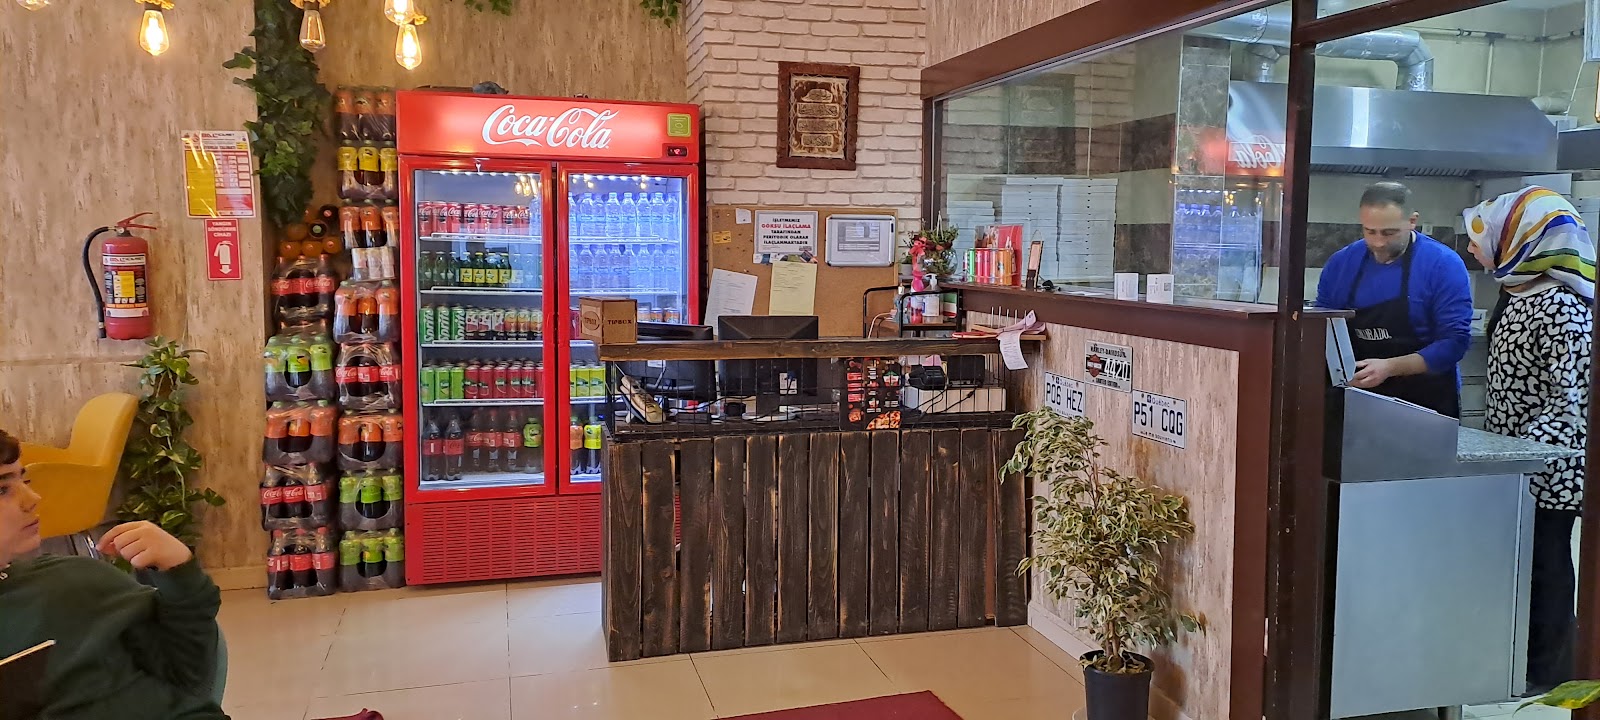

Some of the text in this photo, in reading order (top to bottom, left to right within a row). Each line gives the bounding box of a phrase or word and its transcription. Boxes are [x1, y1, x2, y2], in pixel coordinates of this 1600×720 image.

[482, 104, 620, 149] Coca-Cola
[1104, 358, 1128, 381] 4420
[1066, 388, 1083, 413] HEZ
[1134, 401, 1183, 436] P51 CQG
